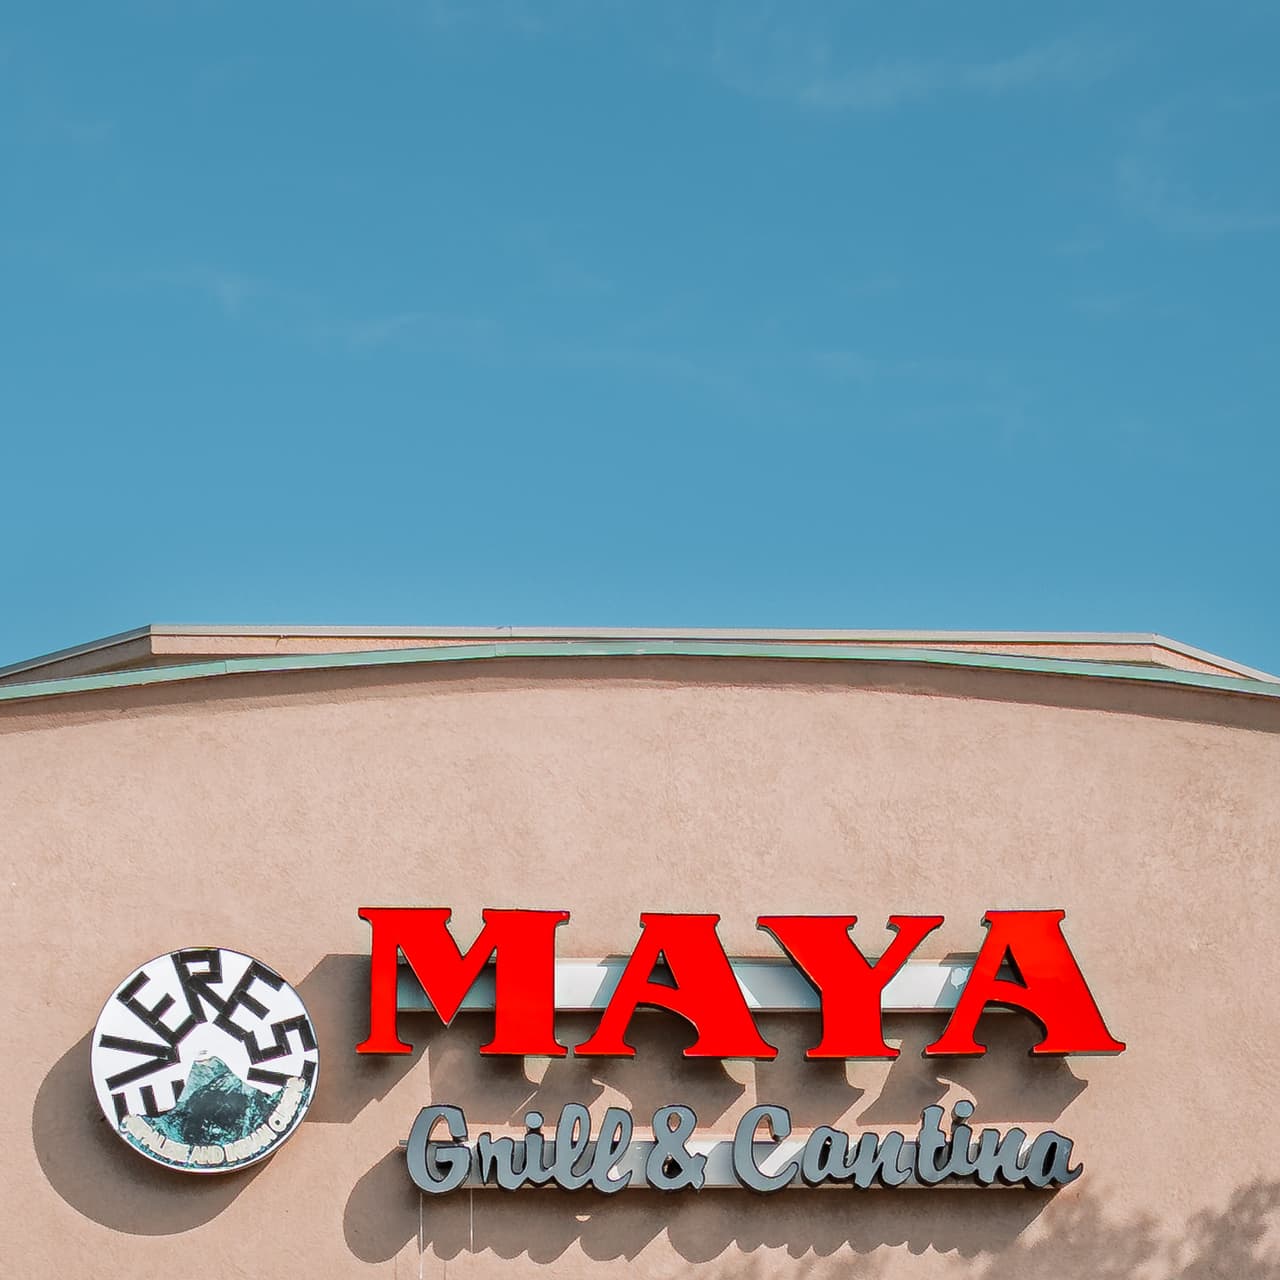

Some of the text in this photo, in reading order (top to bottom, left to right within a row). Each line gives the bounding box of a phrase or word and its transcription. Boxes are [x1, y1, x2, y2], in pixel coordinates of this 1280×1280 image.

[98, 948, 318, 1126] EVEREST
[355, 907, 1127, 1060] MAYA
[189, 1144, 226, 1165] AND
[405, 1100, 1085, 1195] Grill & Cantina
